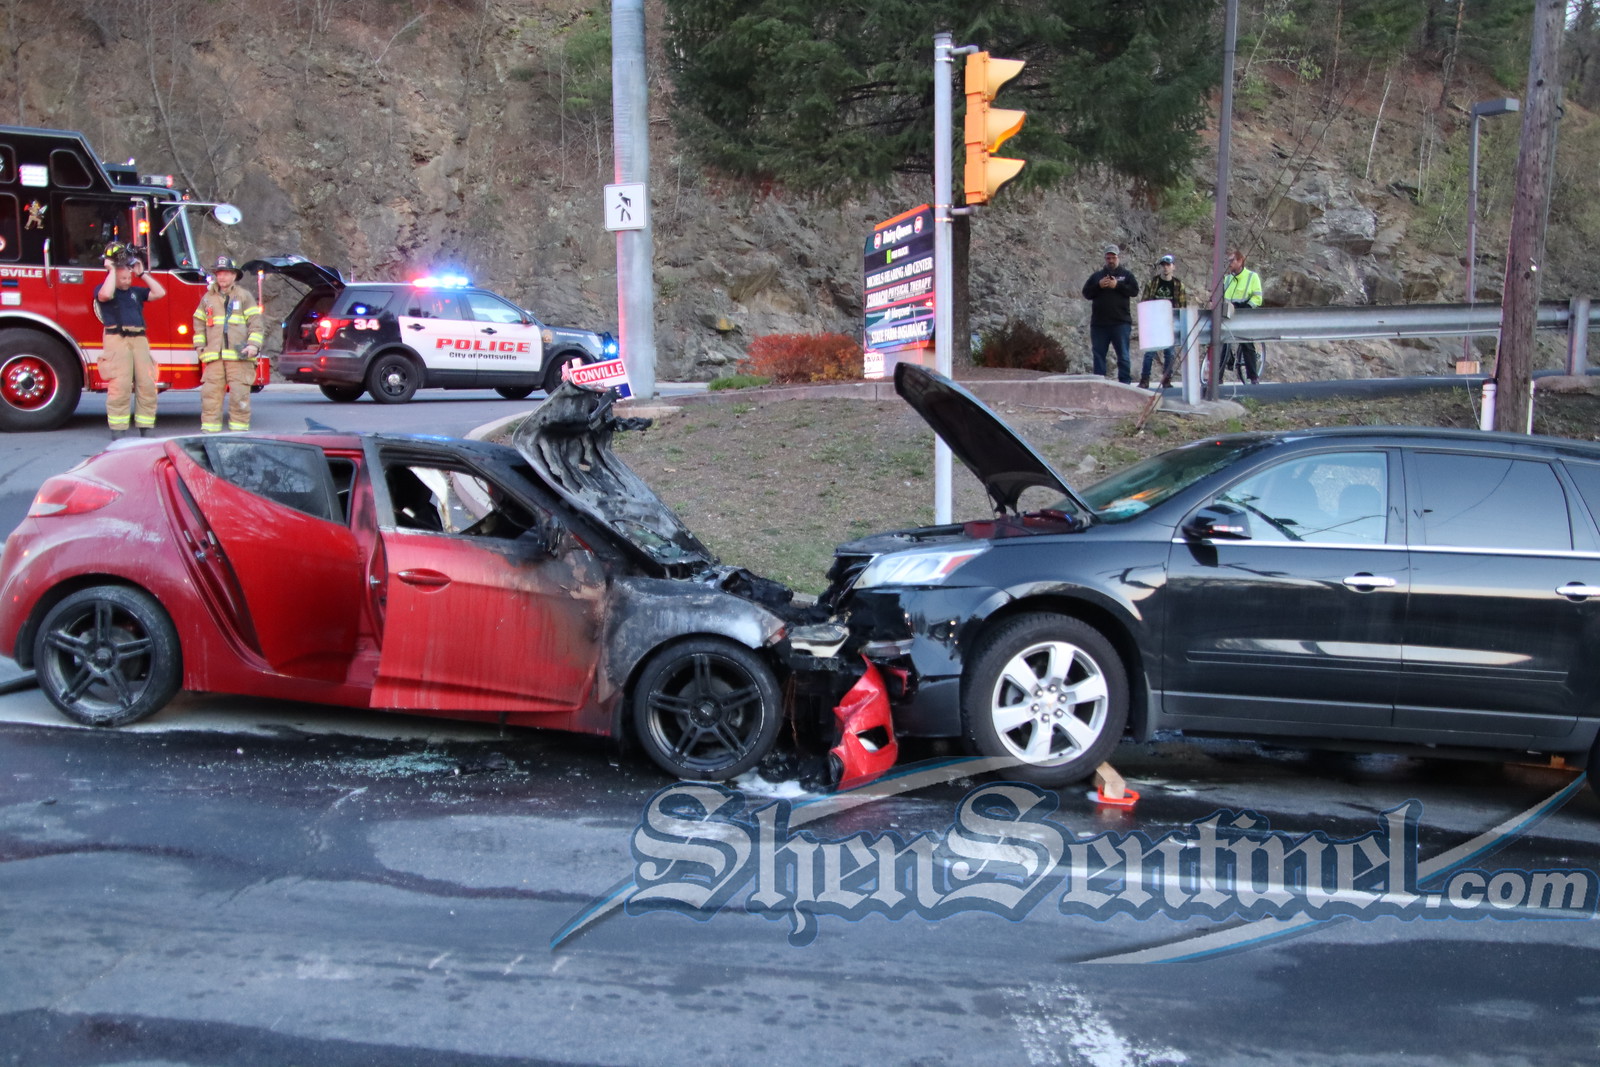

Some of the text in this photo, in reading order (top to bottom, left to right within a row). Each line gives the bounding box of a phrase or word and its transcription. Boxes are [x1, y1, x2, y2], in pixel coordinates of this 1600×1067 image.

[912, 256, 933, 274] CENTER
[910, 276, 932, 292] THERAPY
[353, 318, 380, 331] 34
[897, 321, 928, 339] INSURANCE
[435, 337, 531, 354] POLICE
[449, 351, 518, 361] City of Pottsville
[573, 363, 625, 384] CONVILLE
